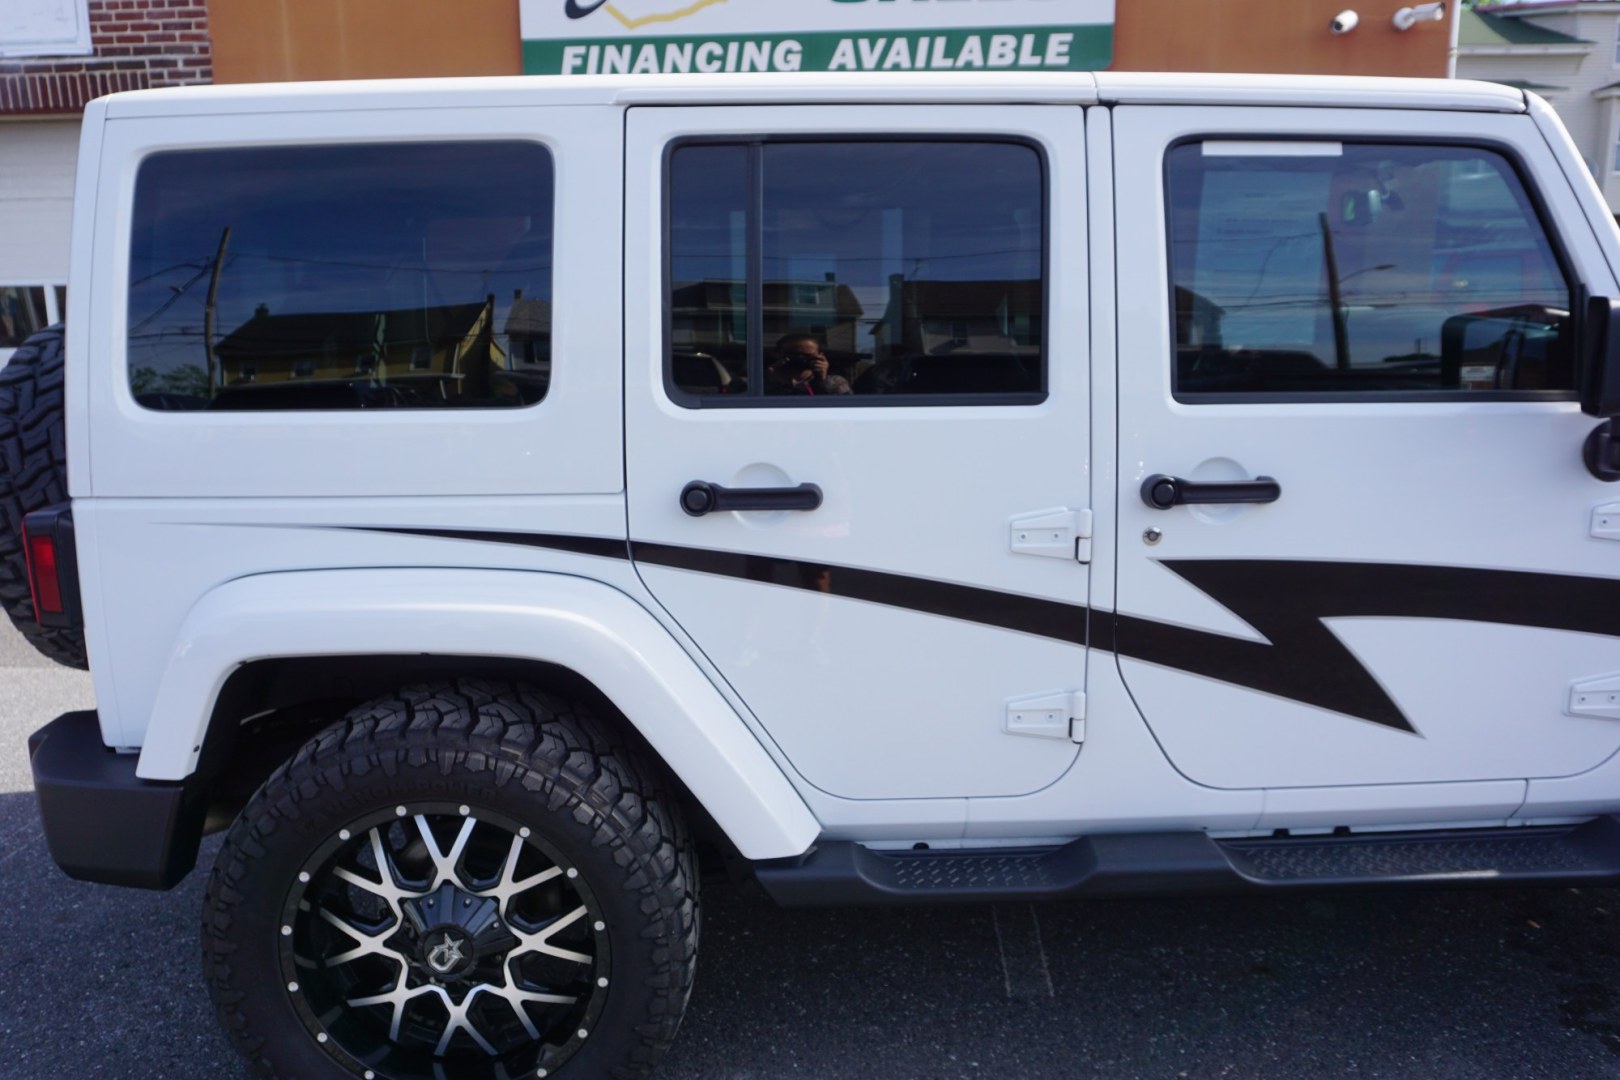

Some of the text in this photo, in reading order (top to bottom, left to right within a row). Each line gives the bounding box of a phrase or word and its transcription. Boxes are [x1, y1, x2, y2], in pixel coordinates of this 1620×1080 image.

[561, 33, 1074, 75] FINANCING AVAILABLE
[415, 779, 498, 801] POWER
